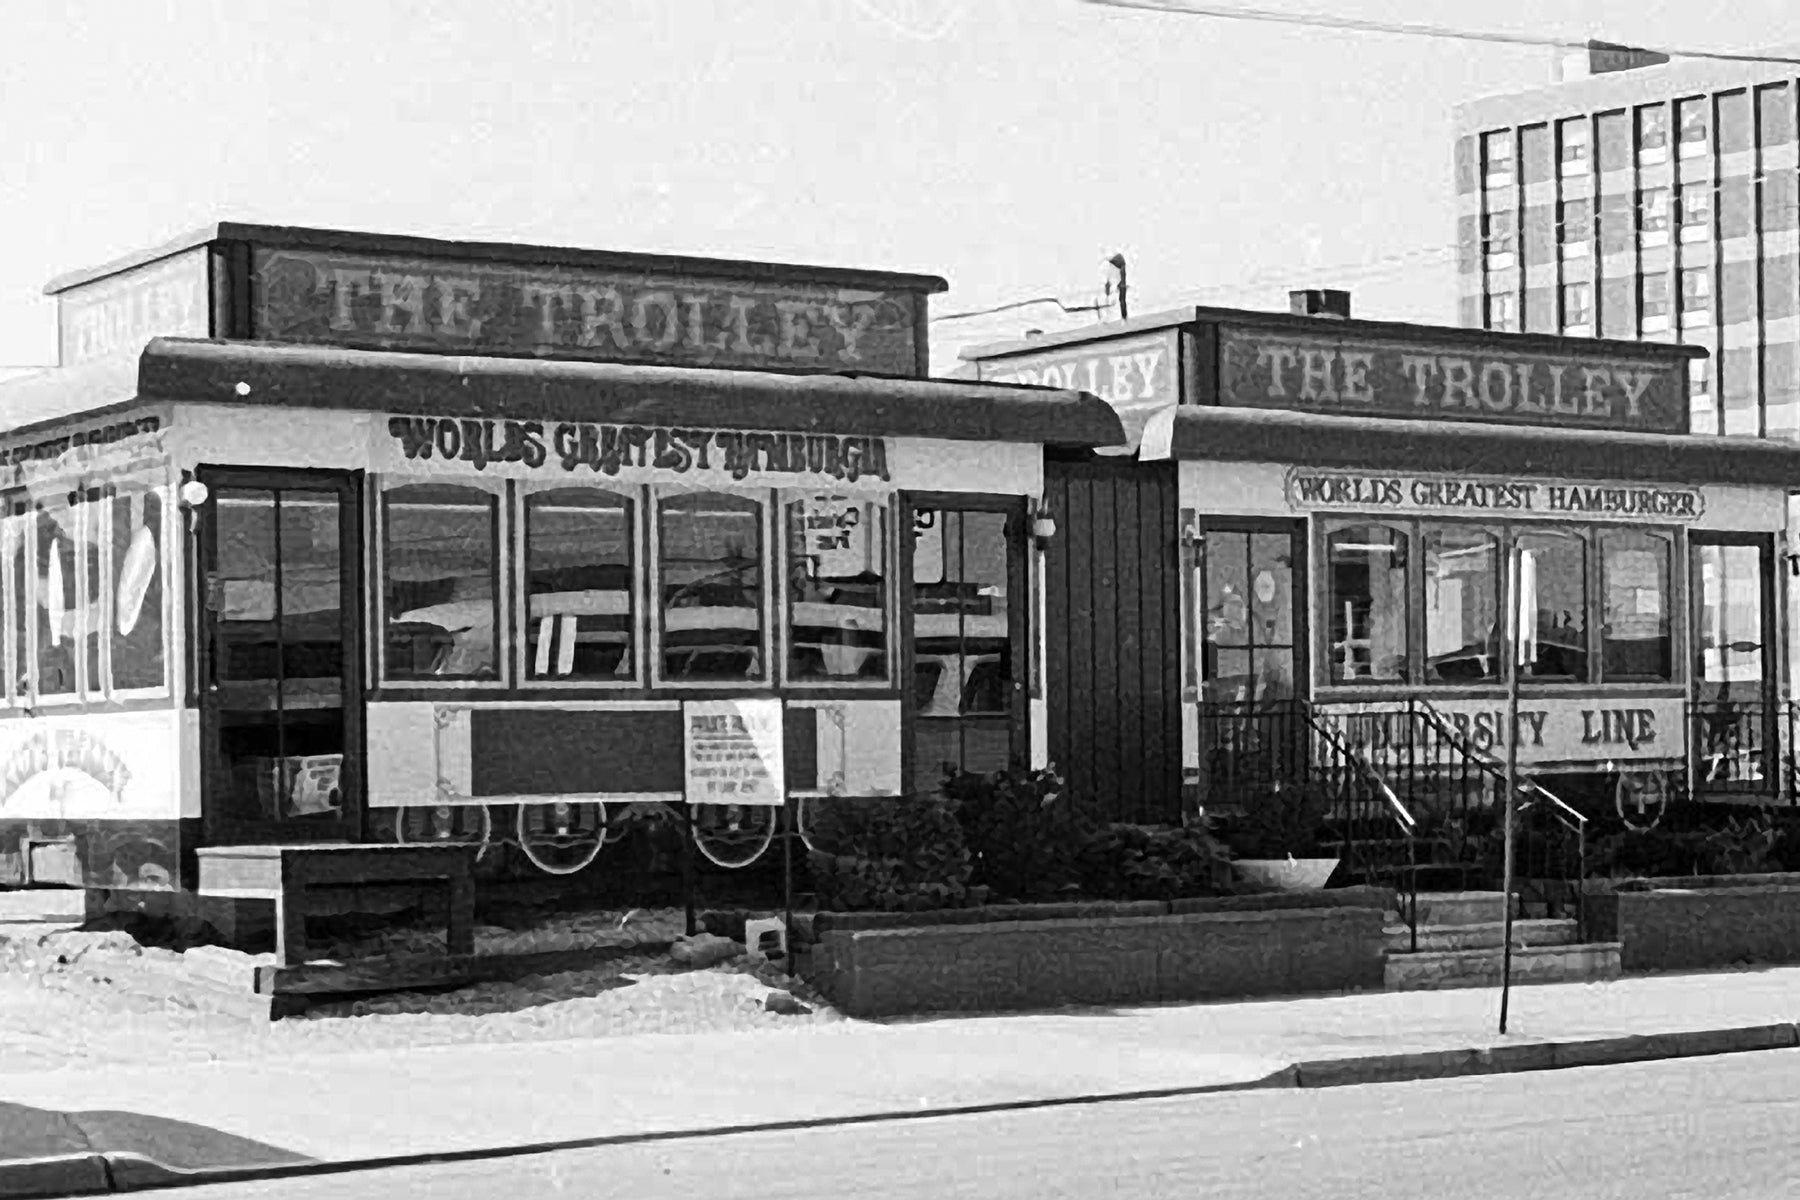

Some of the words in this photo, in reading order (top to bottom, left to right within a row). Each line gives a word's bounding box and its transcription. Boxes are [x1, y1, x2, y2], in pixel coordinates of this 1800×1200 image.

[1256, 346, 1374, 403] THE
[1401, 354, 1653, 417] TROLLEY
[1410, 479, 1538, 510] GREATEST
[1549, 485, 1697, 517] HAMBURGER
[1581, 708, 1657, 751] LINE
